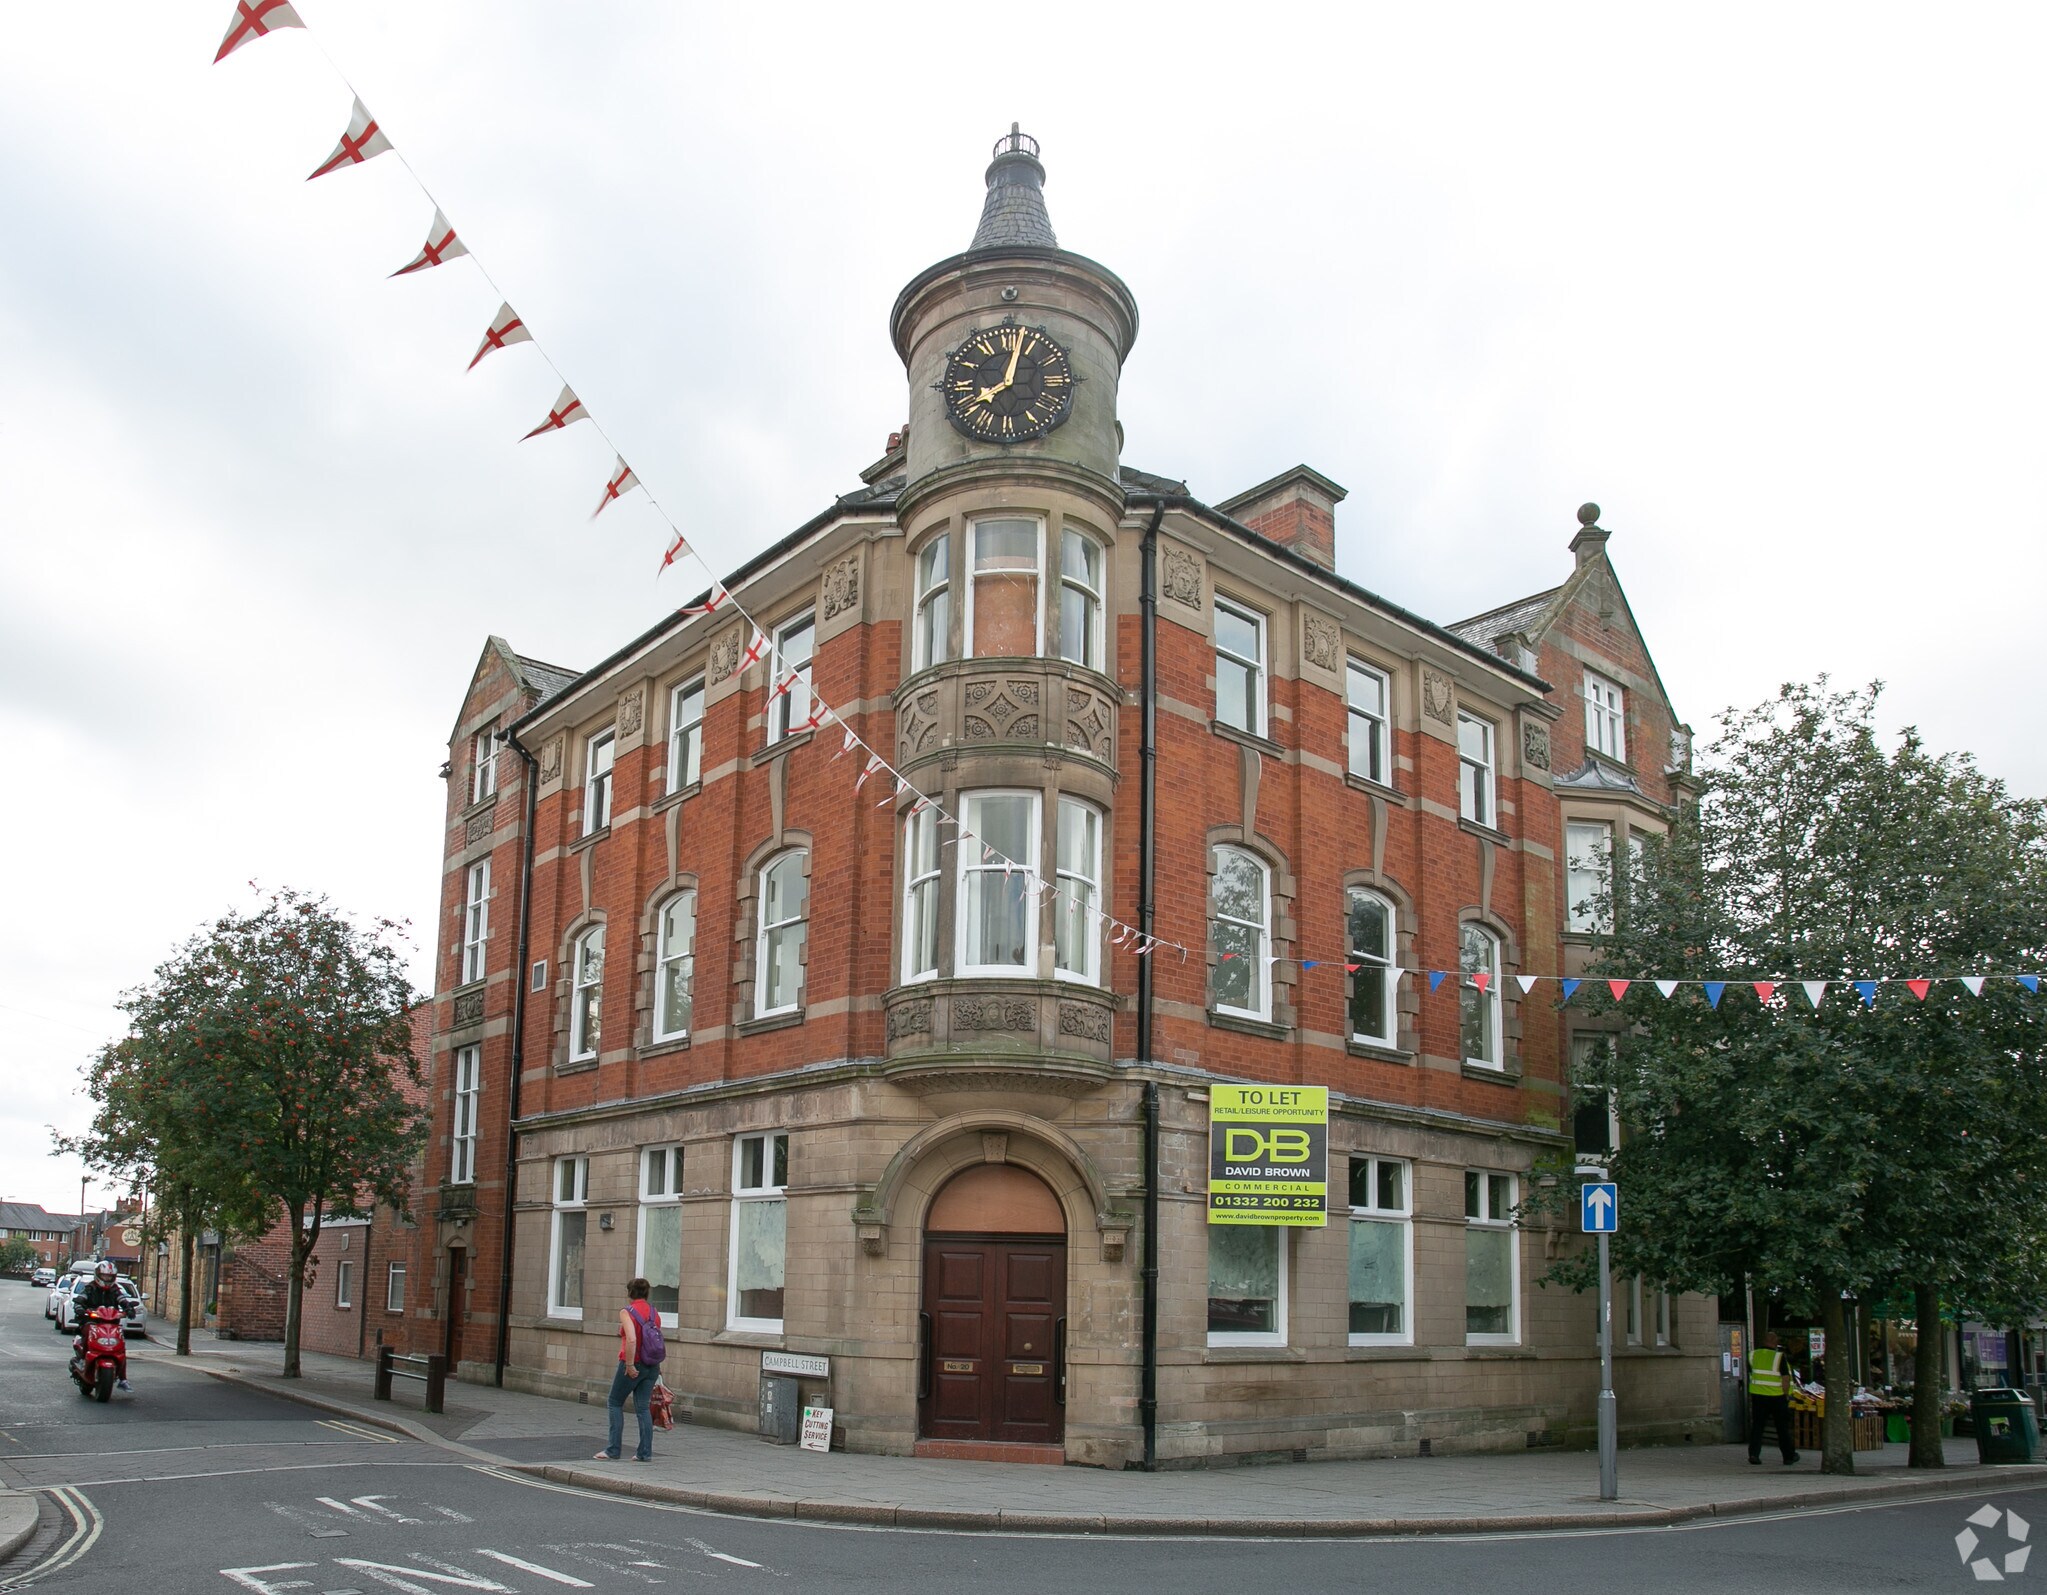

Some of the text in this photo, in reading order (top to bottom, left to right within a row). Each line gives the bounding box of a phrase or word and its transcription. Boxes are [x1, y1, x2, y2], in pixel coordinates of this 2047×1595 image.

[1238, 1090, 1301, 1106] TO LET
[1214, 1107, 1324, 1116] RETAIL/LEISURE OPPORTUNITY
[1225, 1167, 1310, 1177] DAVID BROWN
[1225, 1183, 1310, 1191] COMMERCIAL
[1215, 1196, 1320, 1208] 01332 200 232
[1215, 1213, 1320, 1222] www.davidbrownproperty.com
[764, 1356, 827, 1372] CAMPBELL STREET
[811, 1409, 824, 1418] KEY
[804, 1419, 828, 1430] CUTTING
[804, 1430, 828, 1440] SERVICE
